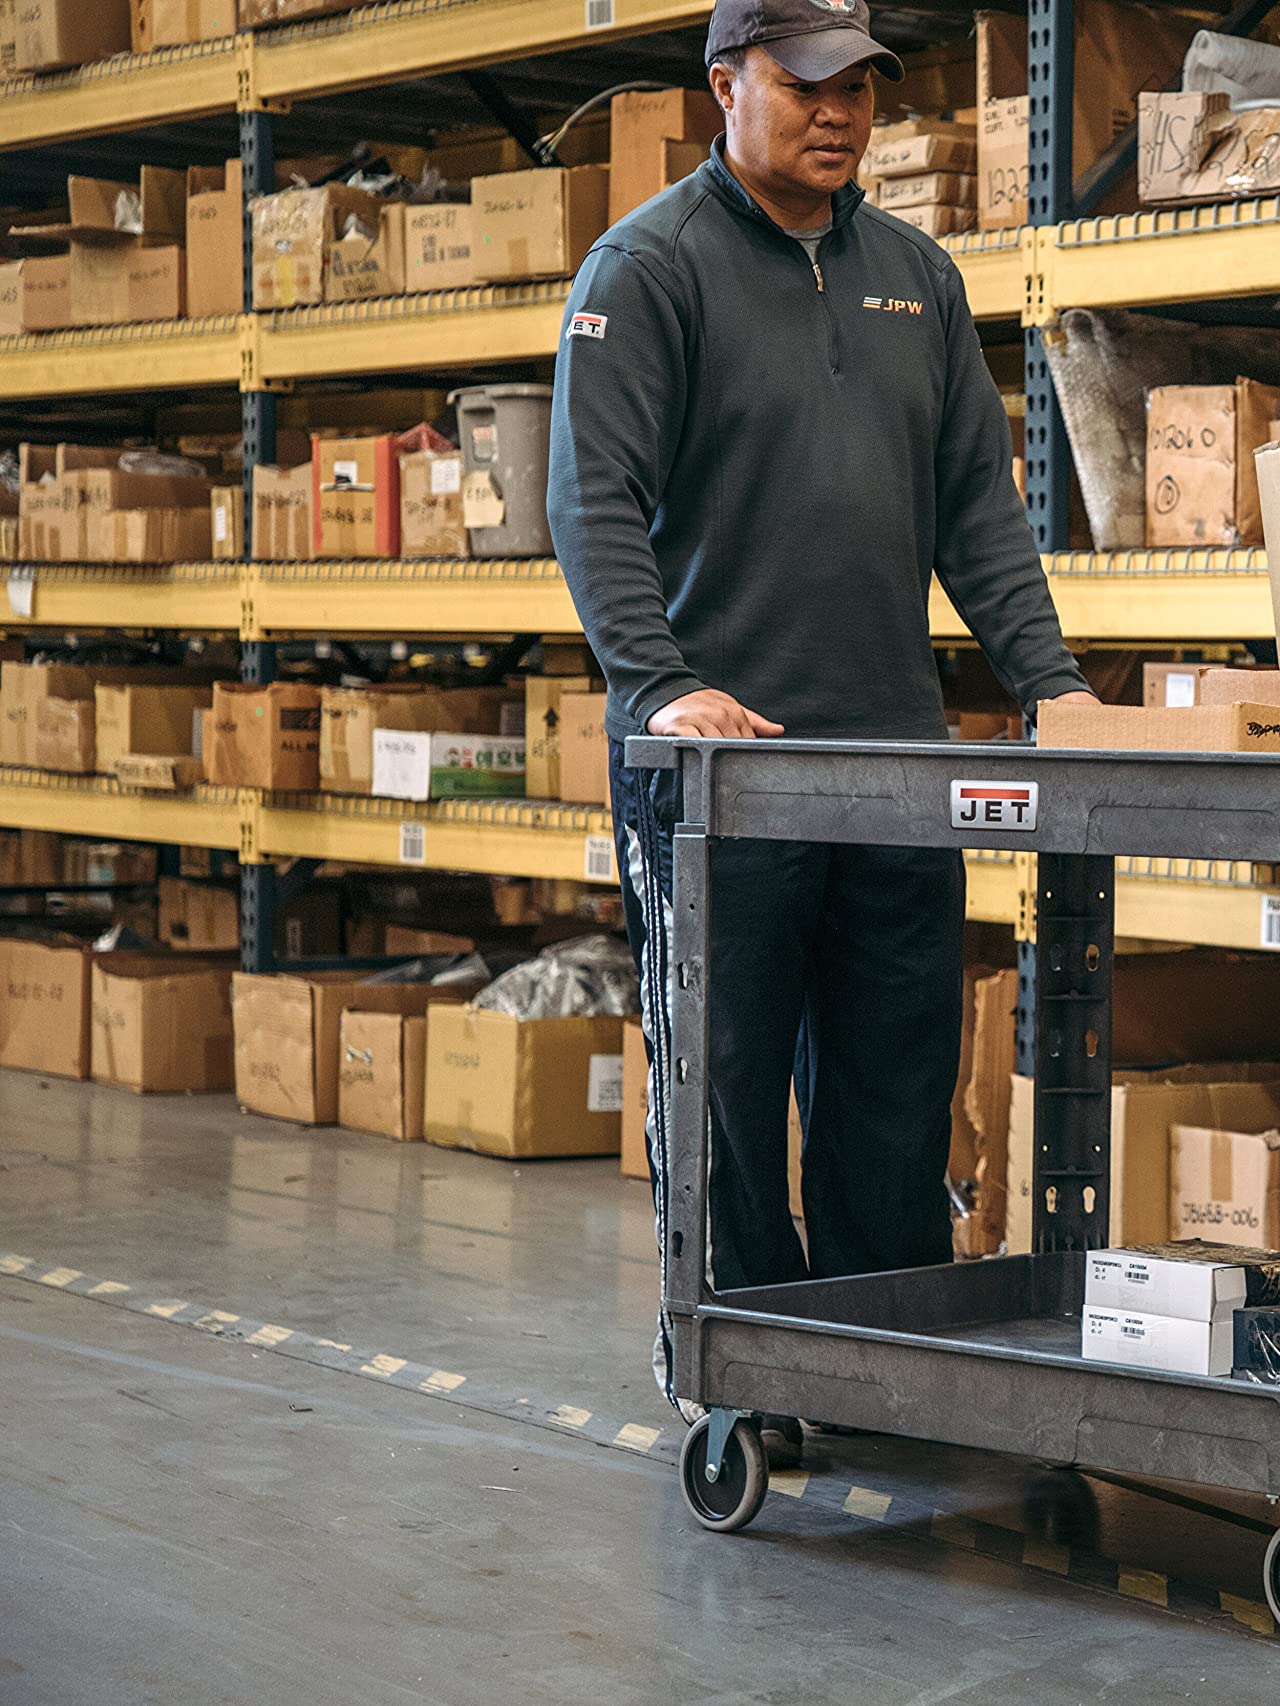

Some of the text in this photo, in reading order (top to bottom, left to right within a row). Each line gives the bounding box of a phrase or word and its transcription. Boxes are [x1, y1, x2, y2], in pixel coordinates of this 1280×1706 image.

[883, 298, 923, 316] JPW
[571, 321, 601, 336] ET
[961, 801, 1029, 823] JET
